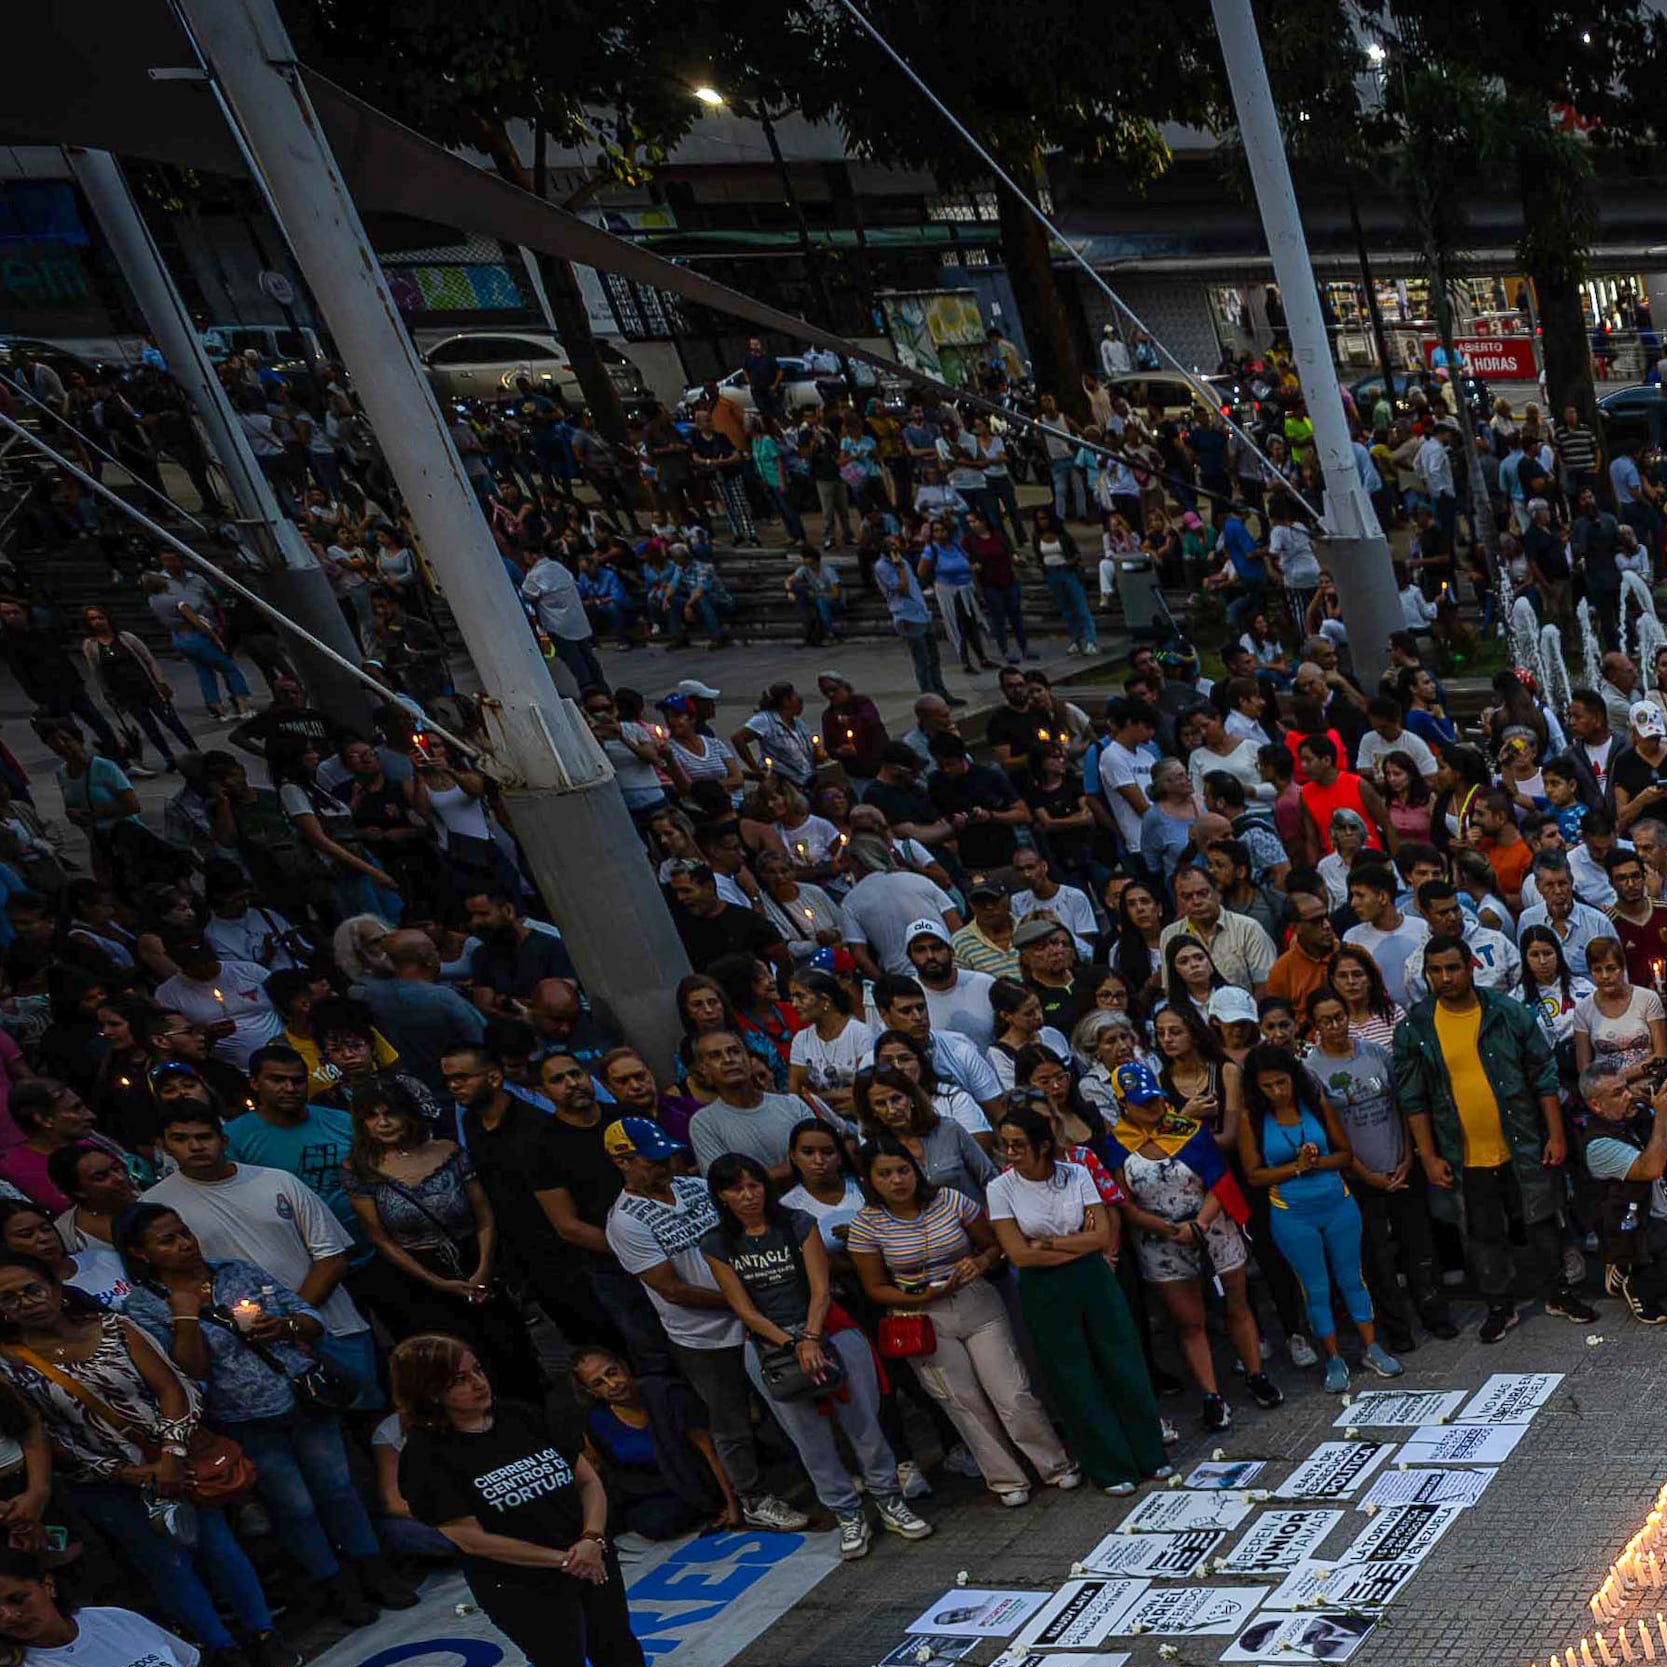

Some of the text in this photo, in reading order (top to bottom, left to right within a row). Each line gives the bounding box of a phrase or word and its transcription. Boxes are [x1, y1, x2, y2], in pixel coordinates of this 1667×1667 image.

[1474, 356, 1518, 372] HORAS
[1477, 1401, 1499, 1412] NO
[473, 1456, 537, 1490] CIERREN
[482, 1462, 555, 1500] CENTROS
[1292, 1449, 1339, 1487] BASTA DE
[1319, 1447, 1376, 1491] POLÍTICA
[489, 1471, 574, 1514] TORTURA
[1242, 1512, 1316, 1570] JUNIOR
[1267, 1511, 1341, 1569] ALTAMAR
[1349, 1504, 1407, 1559] LA TORTURA
[1400, 1506, 1456, 1560] VENEZUELA
